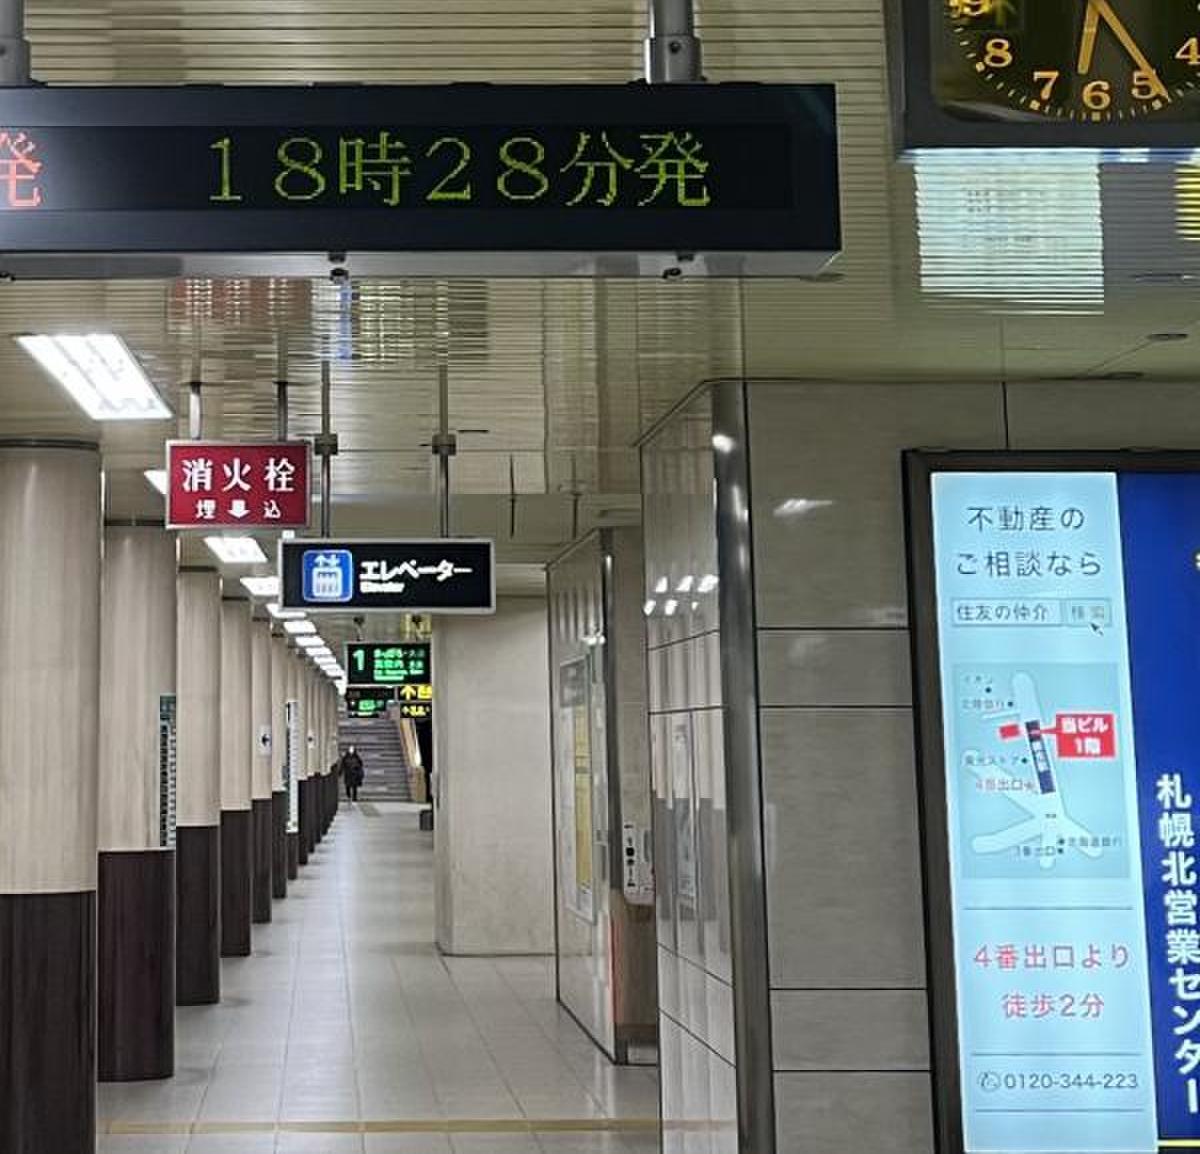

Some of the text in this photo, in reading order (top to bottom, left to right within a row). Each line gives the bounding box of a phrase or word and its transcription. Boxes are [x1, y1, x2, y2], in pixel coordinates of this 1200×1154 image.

[984, 39, 1012, 67] 8
[1175, 37, 1200, 65] 4
[1033, 71, 1059, 99] 7
[1082, 80, 1110, 109] 6
[1131, 71, 1162, 99] 5
[208, 131, 714, 207] 18時28分発
[181, 458, 297, 493] 消火栓
[968, 506, 1085, 532] 不動産の
[359, 559, 473, 582] エレベーター
[956, 550, 1102, 578] ご相談なら
[956, 603, 1049, 622] 住友の仲介
[352, 649, 365, 672] 1
[973, 945, 1129, 969] 4番出口より
[1156, 773, 1200, 1114] 札幌北営業センター
[1001, 994, 1104, 1018] 徒歩2分
[1004, 1074, 1138, 1089] 0120-344-223
